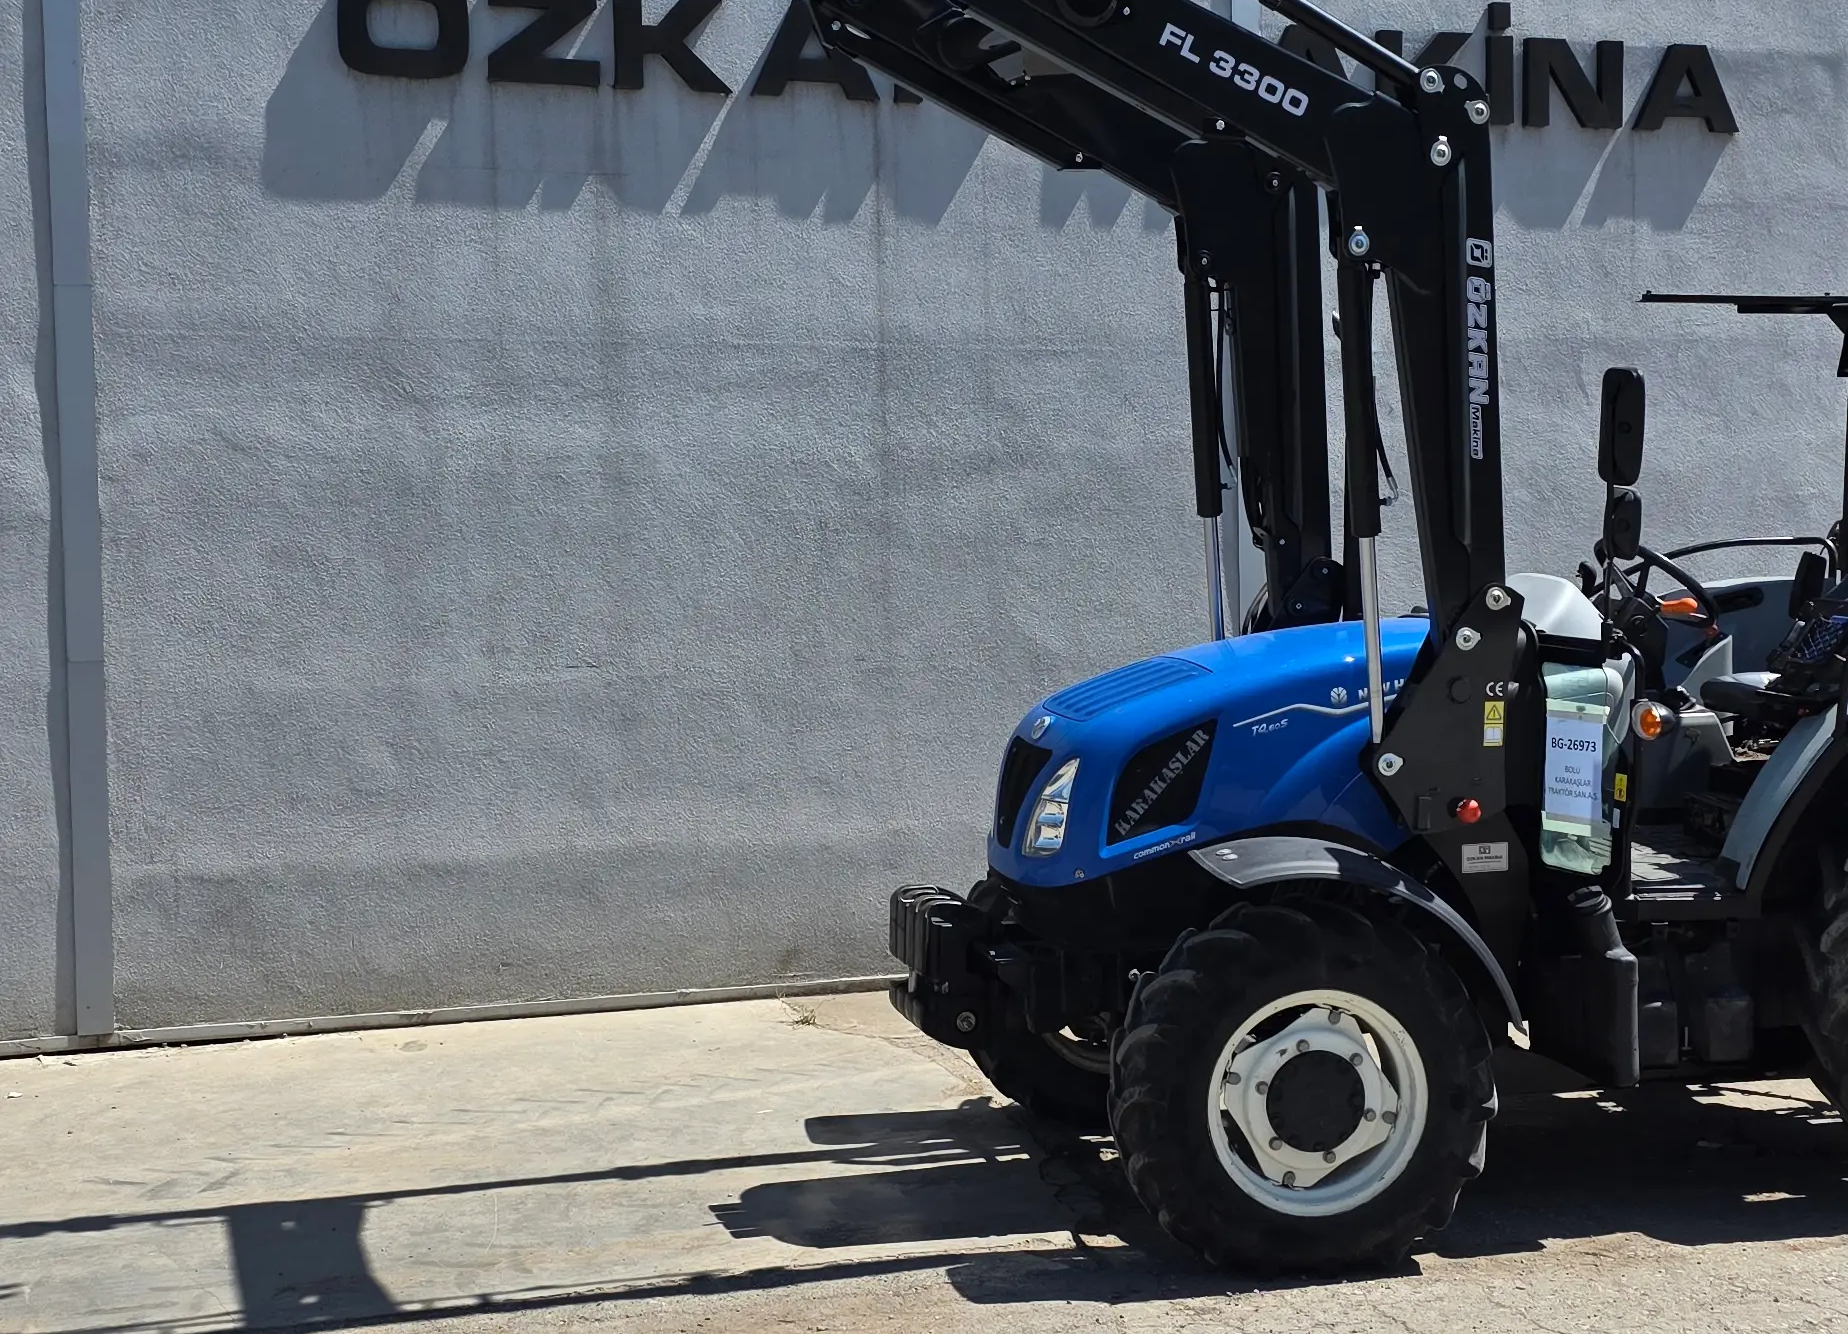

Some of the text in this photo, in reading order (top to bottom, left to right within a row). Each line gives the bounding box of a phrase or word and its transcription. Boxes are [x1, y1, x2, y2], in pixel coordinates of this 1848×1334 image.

[1159, 22, 1309, 117] FL 3300
[1467, 276, 1491, 405] ÖZKAN
[1486, 682, 1503, 696] CE
[1551, 737, 1597, 752] BG-26973
[1565, 765, 1580, 774] BOLU
[1115, 729, 1210, 835] KARAKAŞLAR
